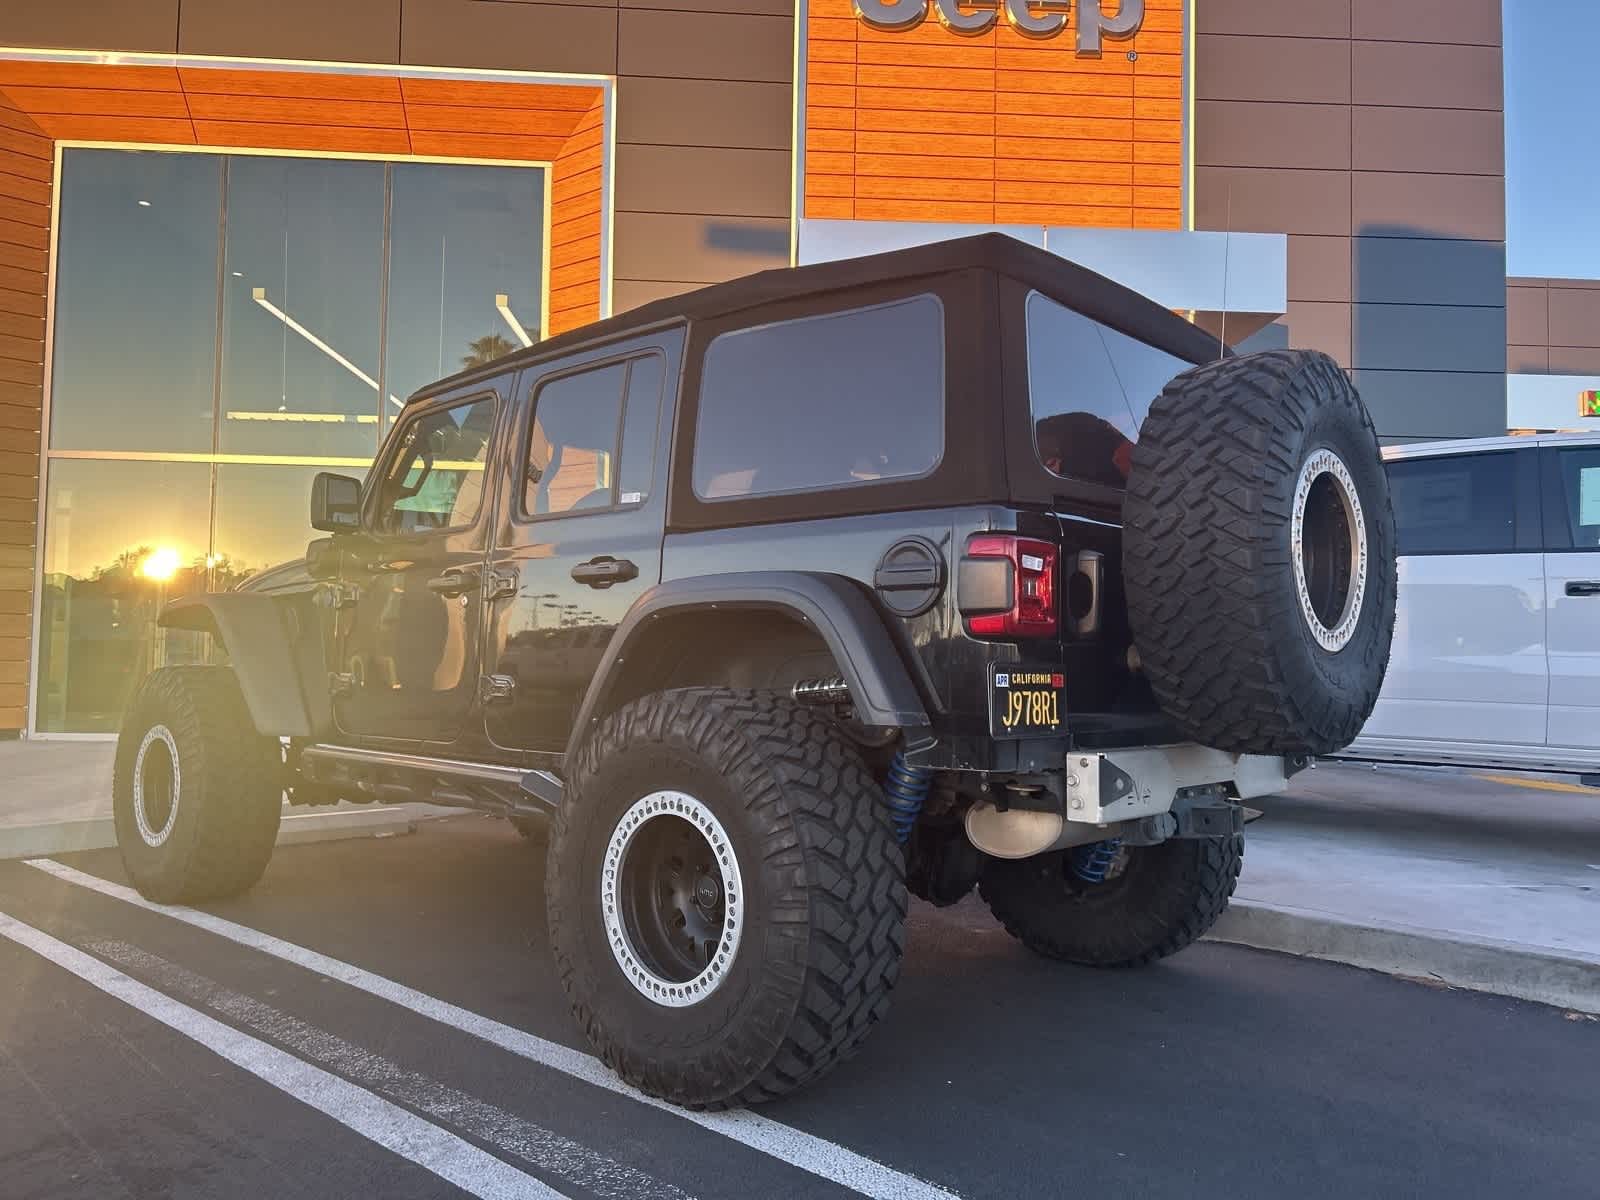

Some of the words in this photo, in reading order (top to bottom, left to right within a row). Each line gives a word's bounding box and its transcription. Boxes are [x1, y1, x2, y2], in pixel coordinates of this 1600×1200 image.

[855, 0, 1145, 57] eep
[997, 675, 1008, 686] APR
[1012, 673, 1051, 684] CALIFORNIA
[1003, 691, 1060, 726] J978R1
